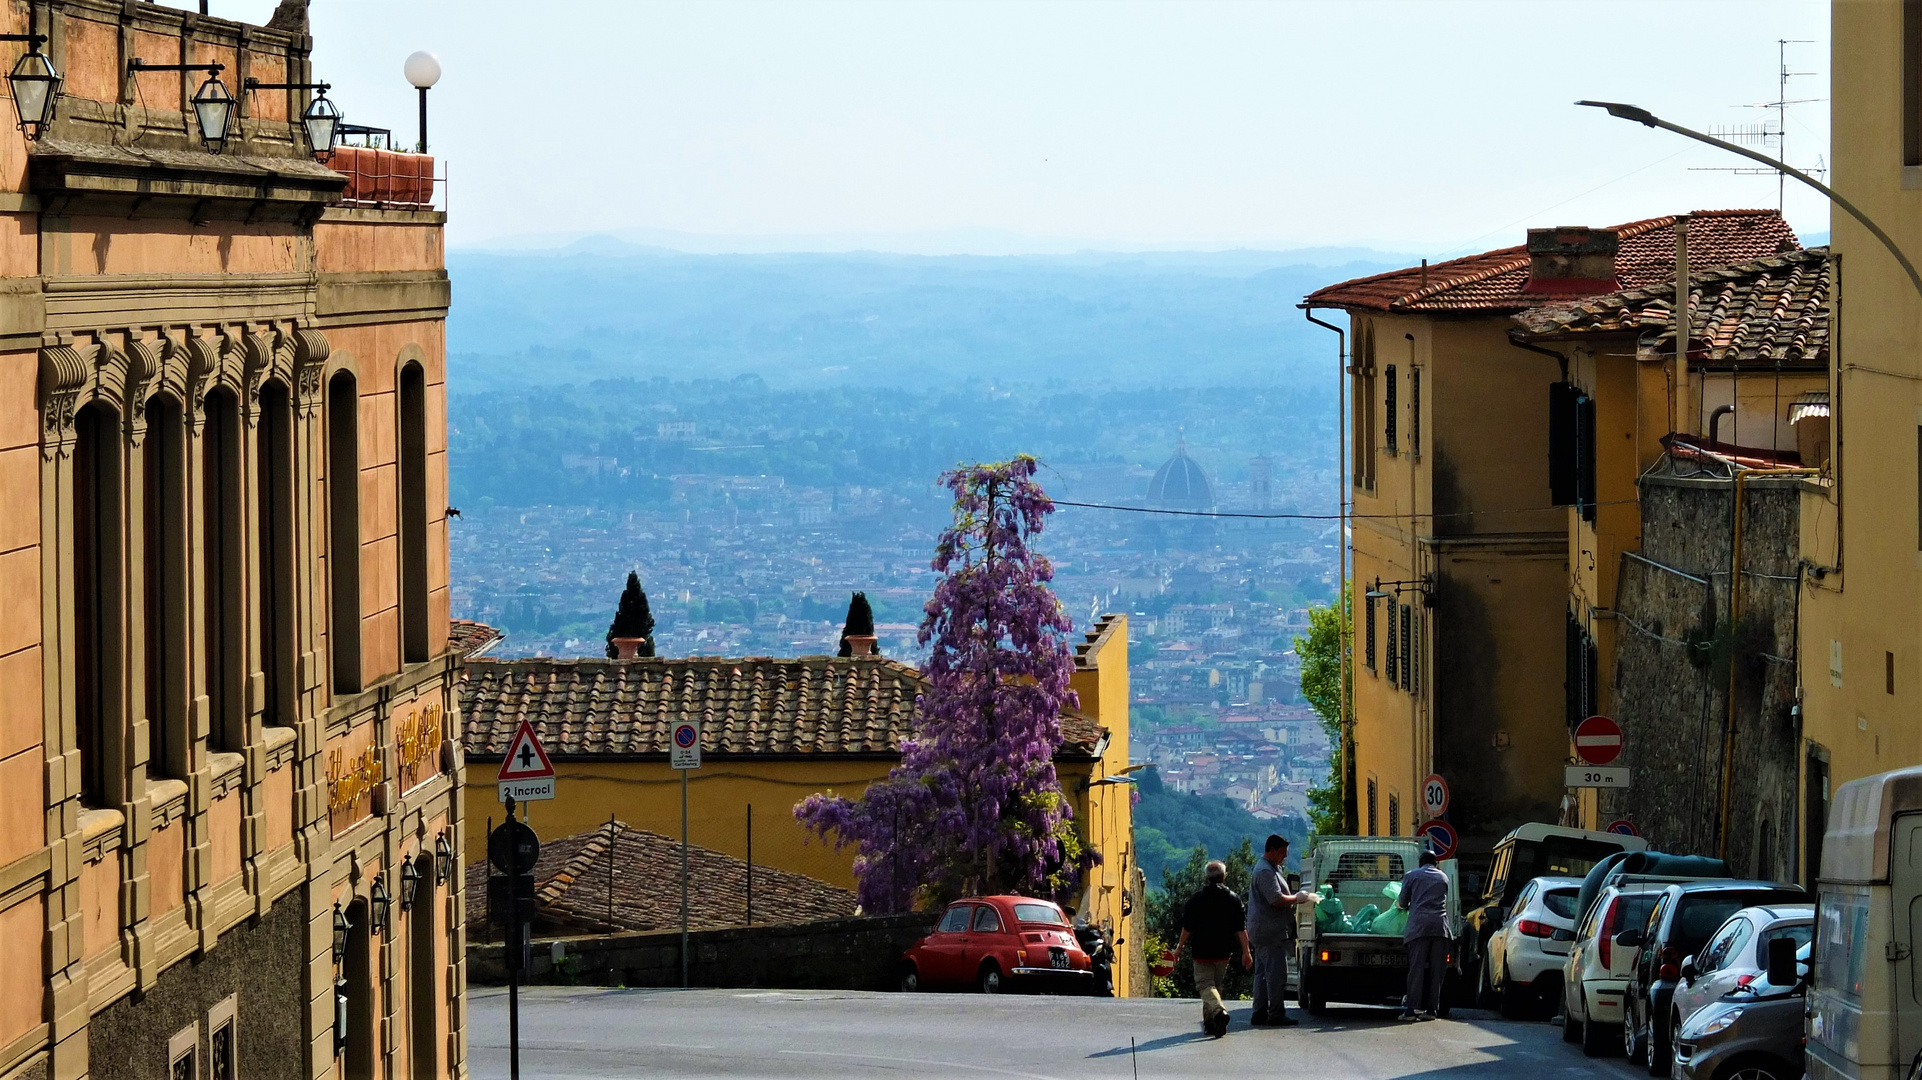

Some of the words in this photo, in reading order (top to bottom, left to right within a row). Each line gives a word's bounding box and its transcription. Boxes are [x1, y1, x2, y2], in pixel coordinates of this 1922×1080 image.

[1584, 773, 1601, 783] 30
[503, 786, 511, 797] 2
[514, 784, 550, 796] incroci
[1427, 785, 1443, 806] 30
